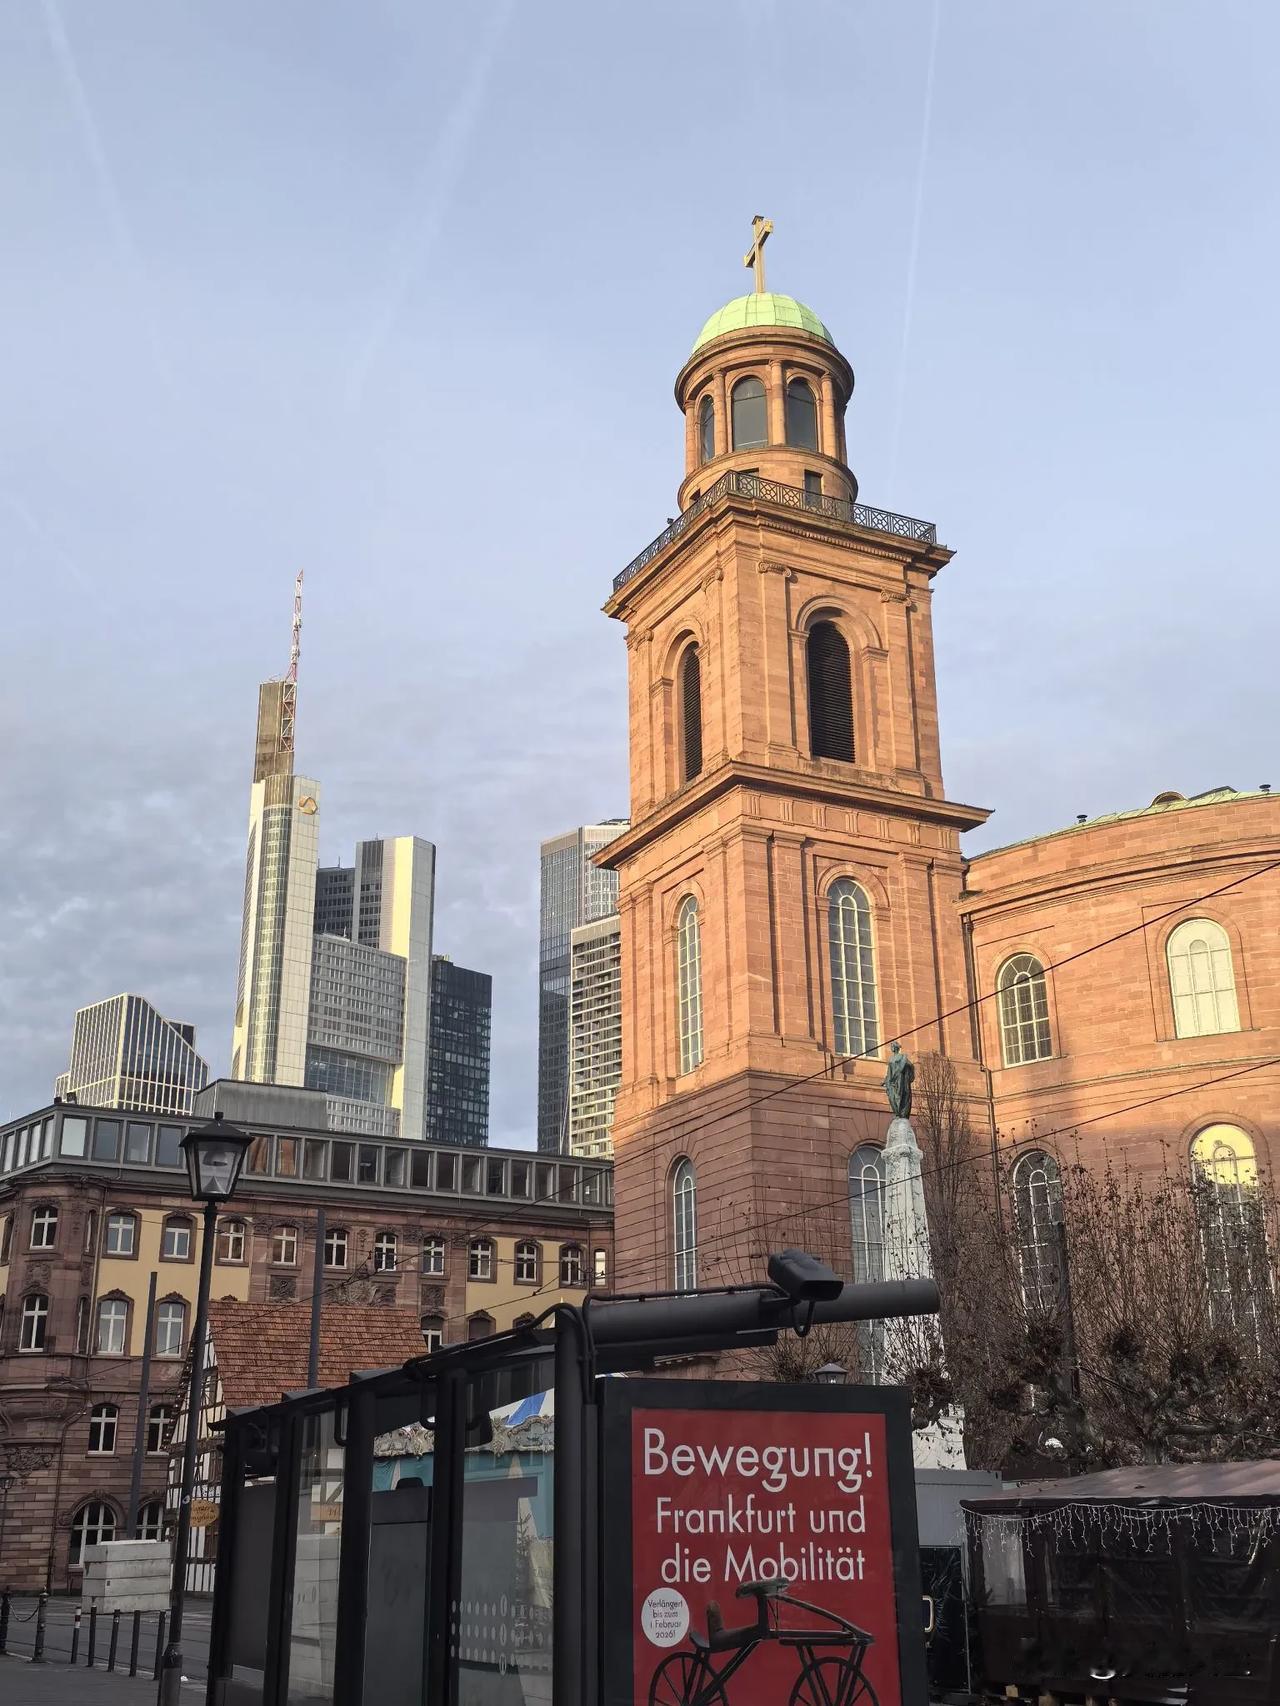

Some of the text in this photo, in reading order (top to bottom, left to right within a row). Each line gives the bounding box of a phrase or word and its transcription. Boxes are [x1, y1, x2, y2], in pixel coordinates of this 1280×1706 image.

[644, 1427, 873, 1493] Bewegung!
[656, 1493, 866, 1534] Frankfurt und
[660, 1541, 866, 1584] die Mobilität
[652, 1609, 663, 1619] bis
[655, 1619, 682, 1629] Februar
